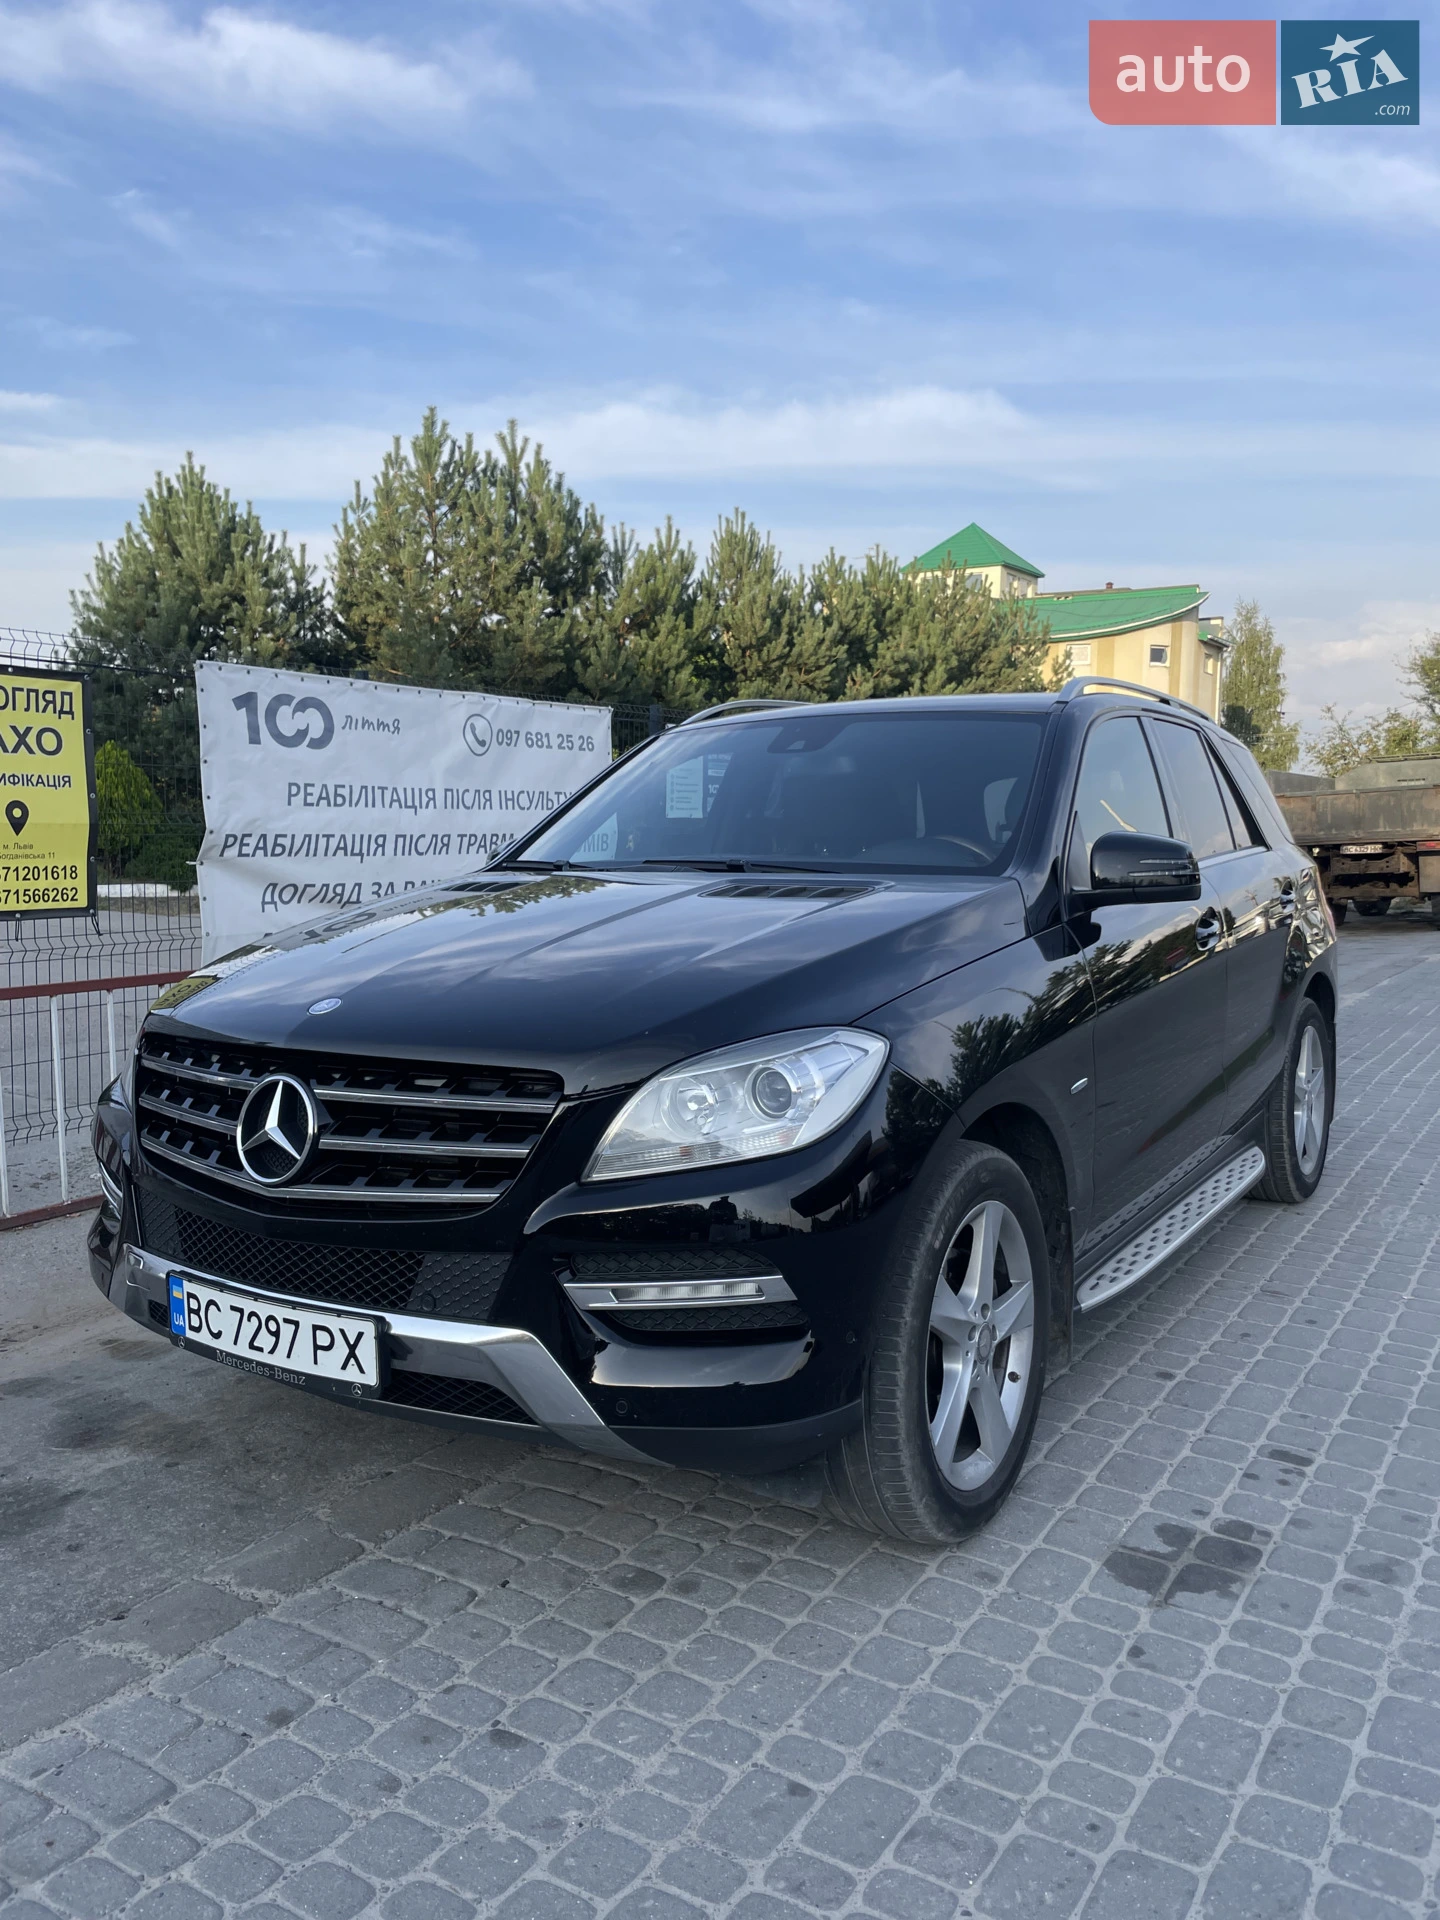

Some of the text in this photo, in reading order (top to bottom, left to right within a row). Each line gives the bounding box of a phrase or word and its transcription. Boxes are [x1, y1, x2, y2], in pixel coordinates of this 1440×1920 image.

[496, 728, 595, 752] 097 681 25 26
[287, 782, 437, 816] РЕАБІЛІТАЦІЯ
[444, 788, 493, 810] ПІСЛЯ
[13, 842, 34, 850] Львів
[219, 833, 387, 864] РЕАБІЛІТАЦІЯ
[393, 833, 451, 856] ПІСЛЯ
[0, 865, 78, 881] 71201618
[0, 887, 78, 904] 71566262
[261, 882, 362, 913] ДОГЛЯД
[371, 881, 395, 899] ЗА
[173, 1312, 185, 1328] UA
[186, 1291, 366, 1375] BC 7297 PX
[216, 1350, 306, 1385] Mercedes-Benz
